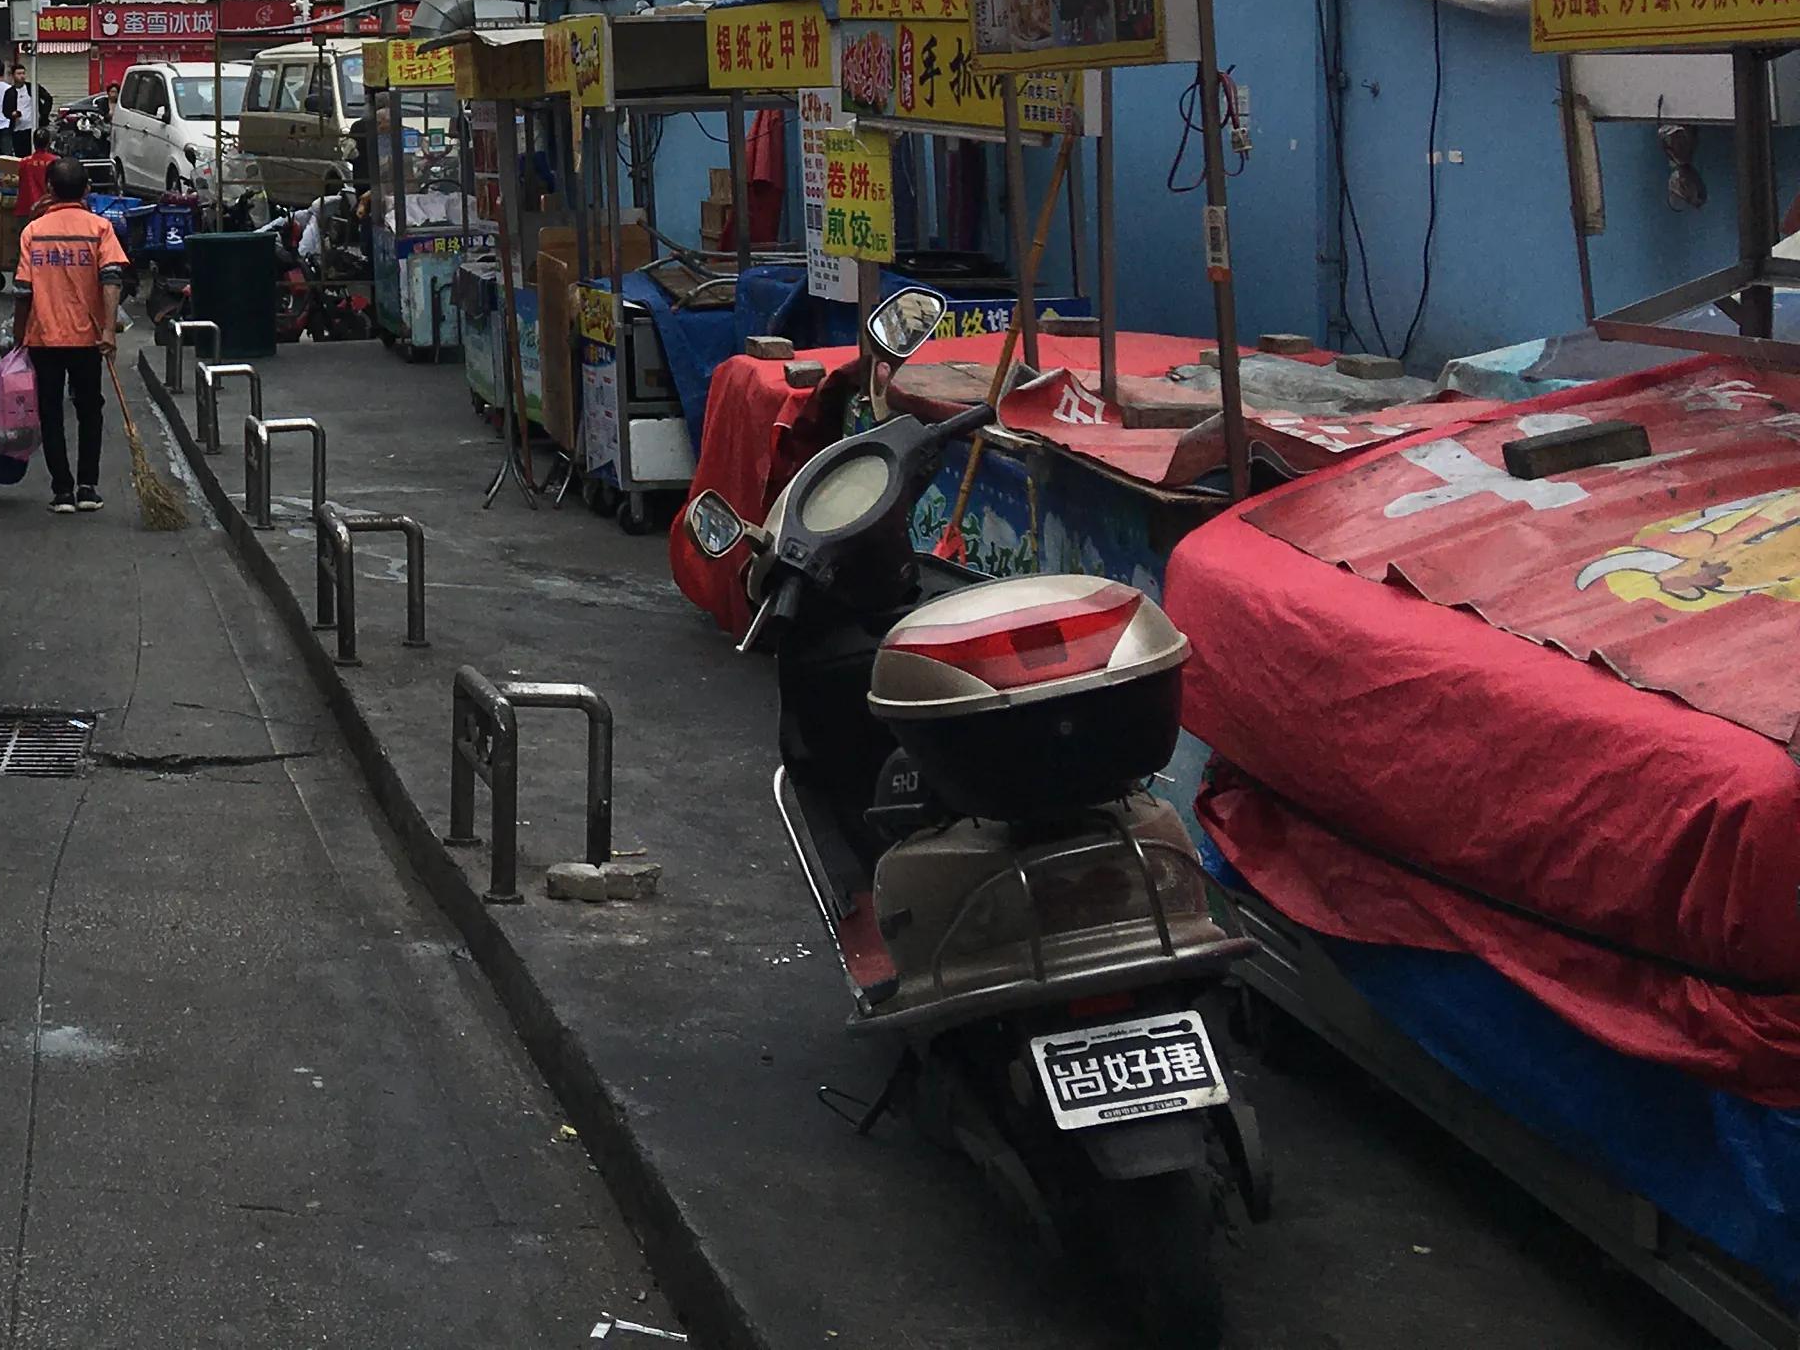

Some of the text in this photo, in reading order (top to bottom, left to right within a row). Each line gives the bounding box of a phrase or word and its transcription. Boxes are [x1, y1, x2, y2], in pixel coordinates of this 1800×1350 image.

[123, 11, 214, 34] 蜜雪冰城
[716, 16, 820, 72] 锡纸花甲粉
[1052, 1041, 1208, 1102] 尚好捷
